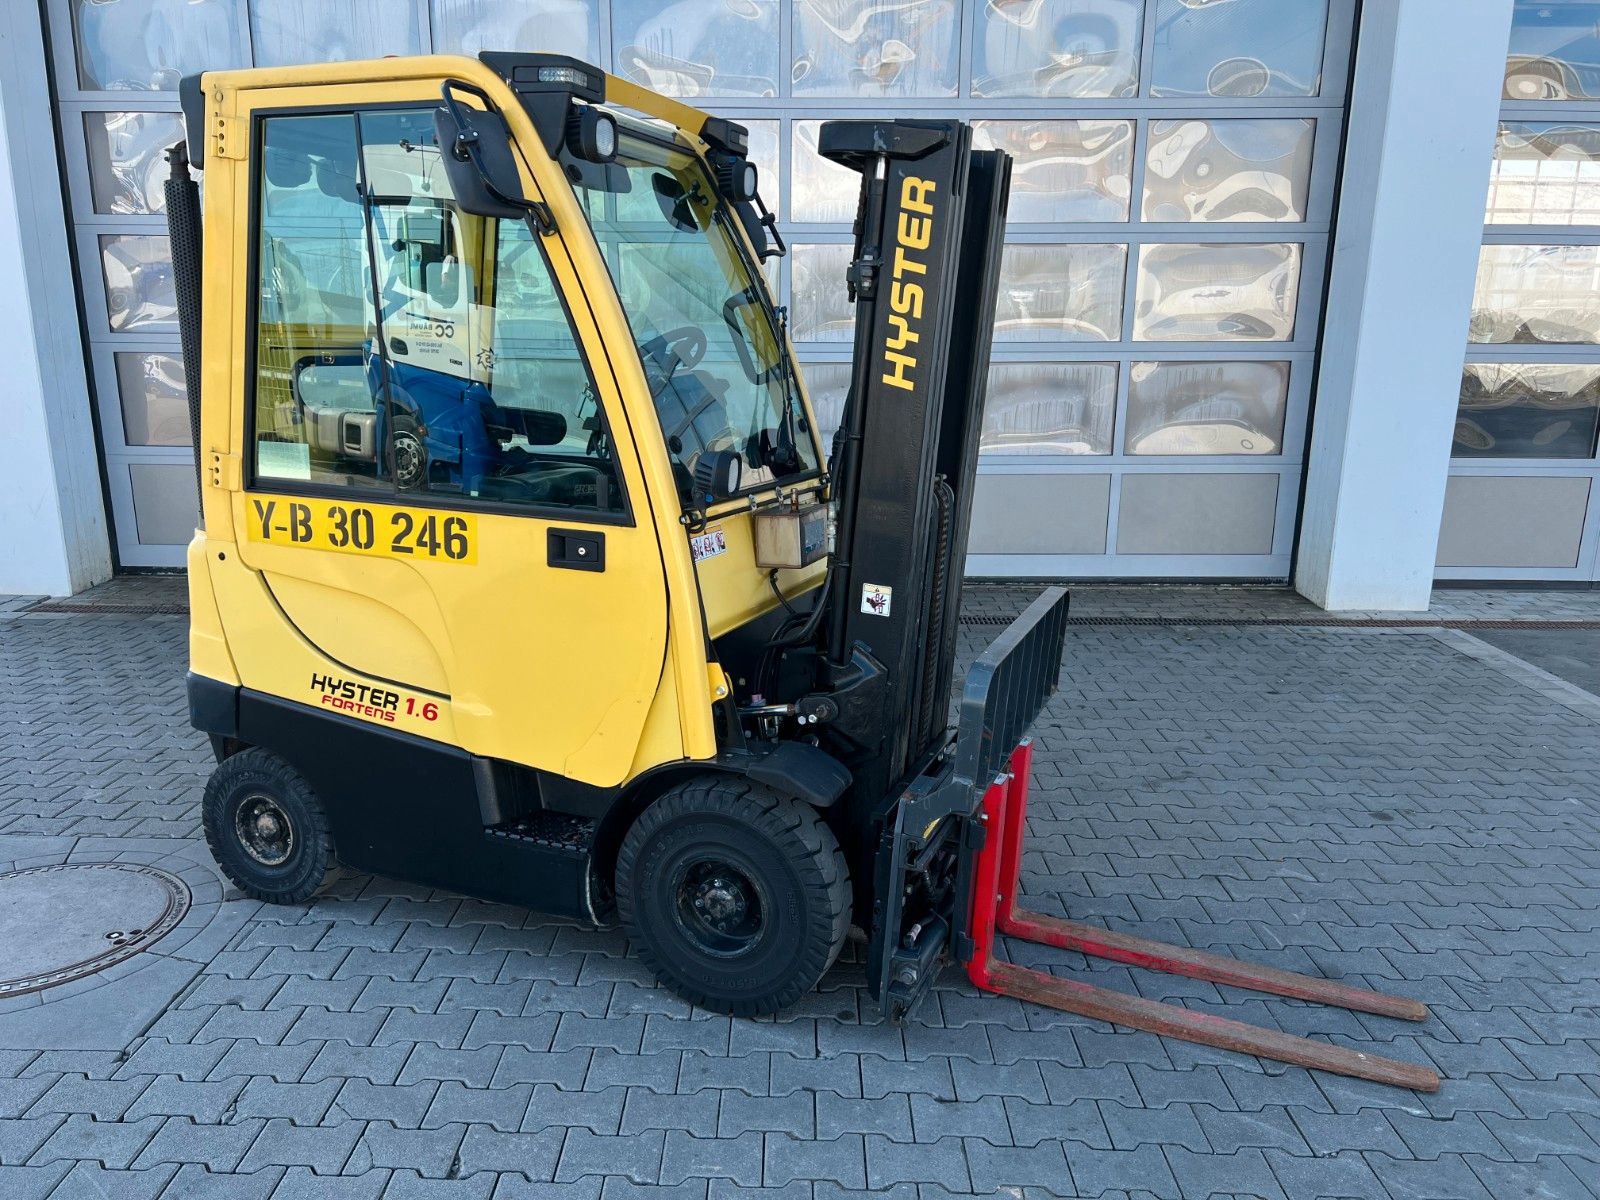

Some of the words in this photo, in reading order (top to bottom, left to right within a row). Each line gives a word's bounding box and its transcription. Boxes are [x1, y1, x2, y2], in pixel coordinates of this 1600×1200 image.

[882, 175, 936, 391] HYSTER
[253, 499, 313, 543] Y-B
[327, 506, 375, 550] 30
[391, 512, 468, 560] 246
[311, 673, 399, 711] HYSTER
[322, 695, 396, 721] FORTENS
[405, 698, 439, 721] 1.6
